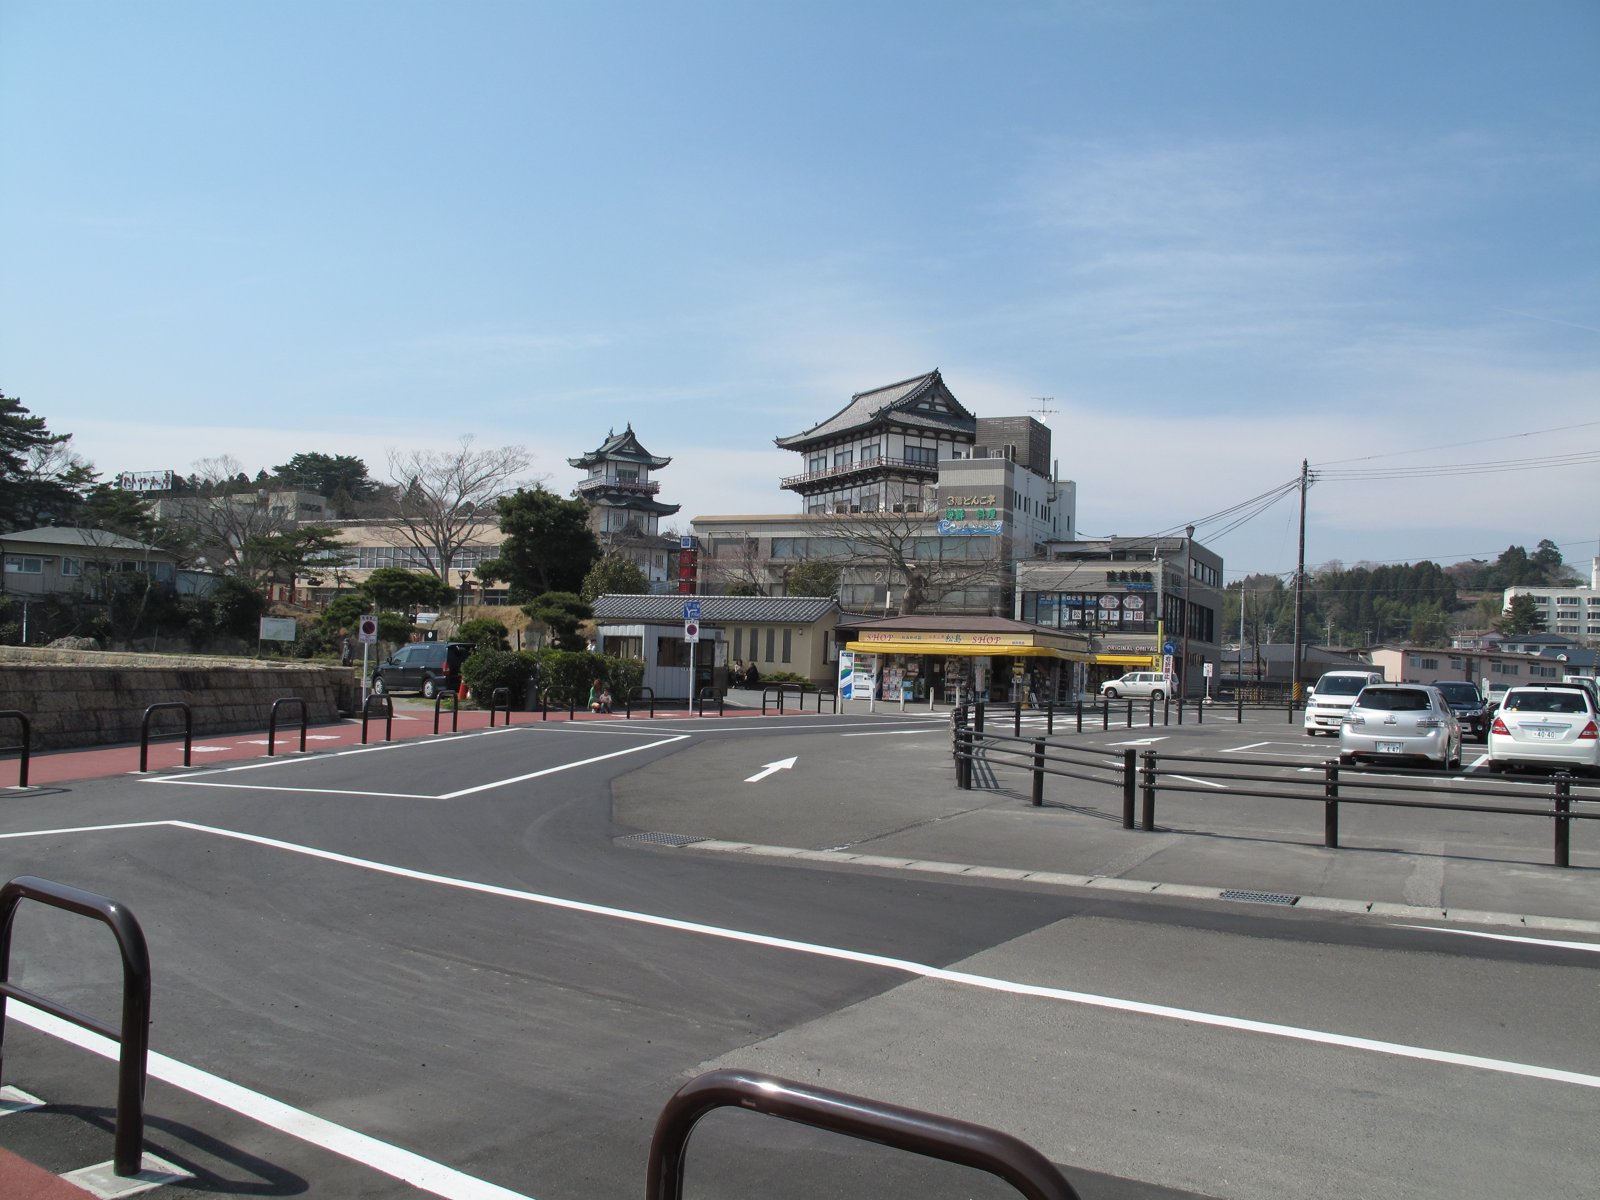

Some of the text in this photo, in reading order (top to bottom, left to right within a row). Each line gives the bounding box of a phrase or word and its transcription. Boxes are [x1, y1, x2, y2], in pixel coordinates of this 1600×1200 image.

[1072, 610, 1144, 621] 松レトロ館
[866, 633, 894, 641] SHOP
[972, 636, 1001, 644] SHOP
[1164, 656, 1172, 680] 右折禁止
